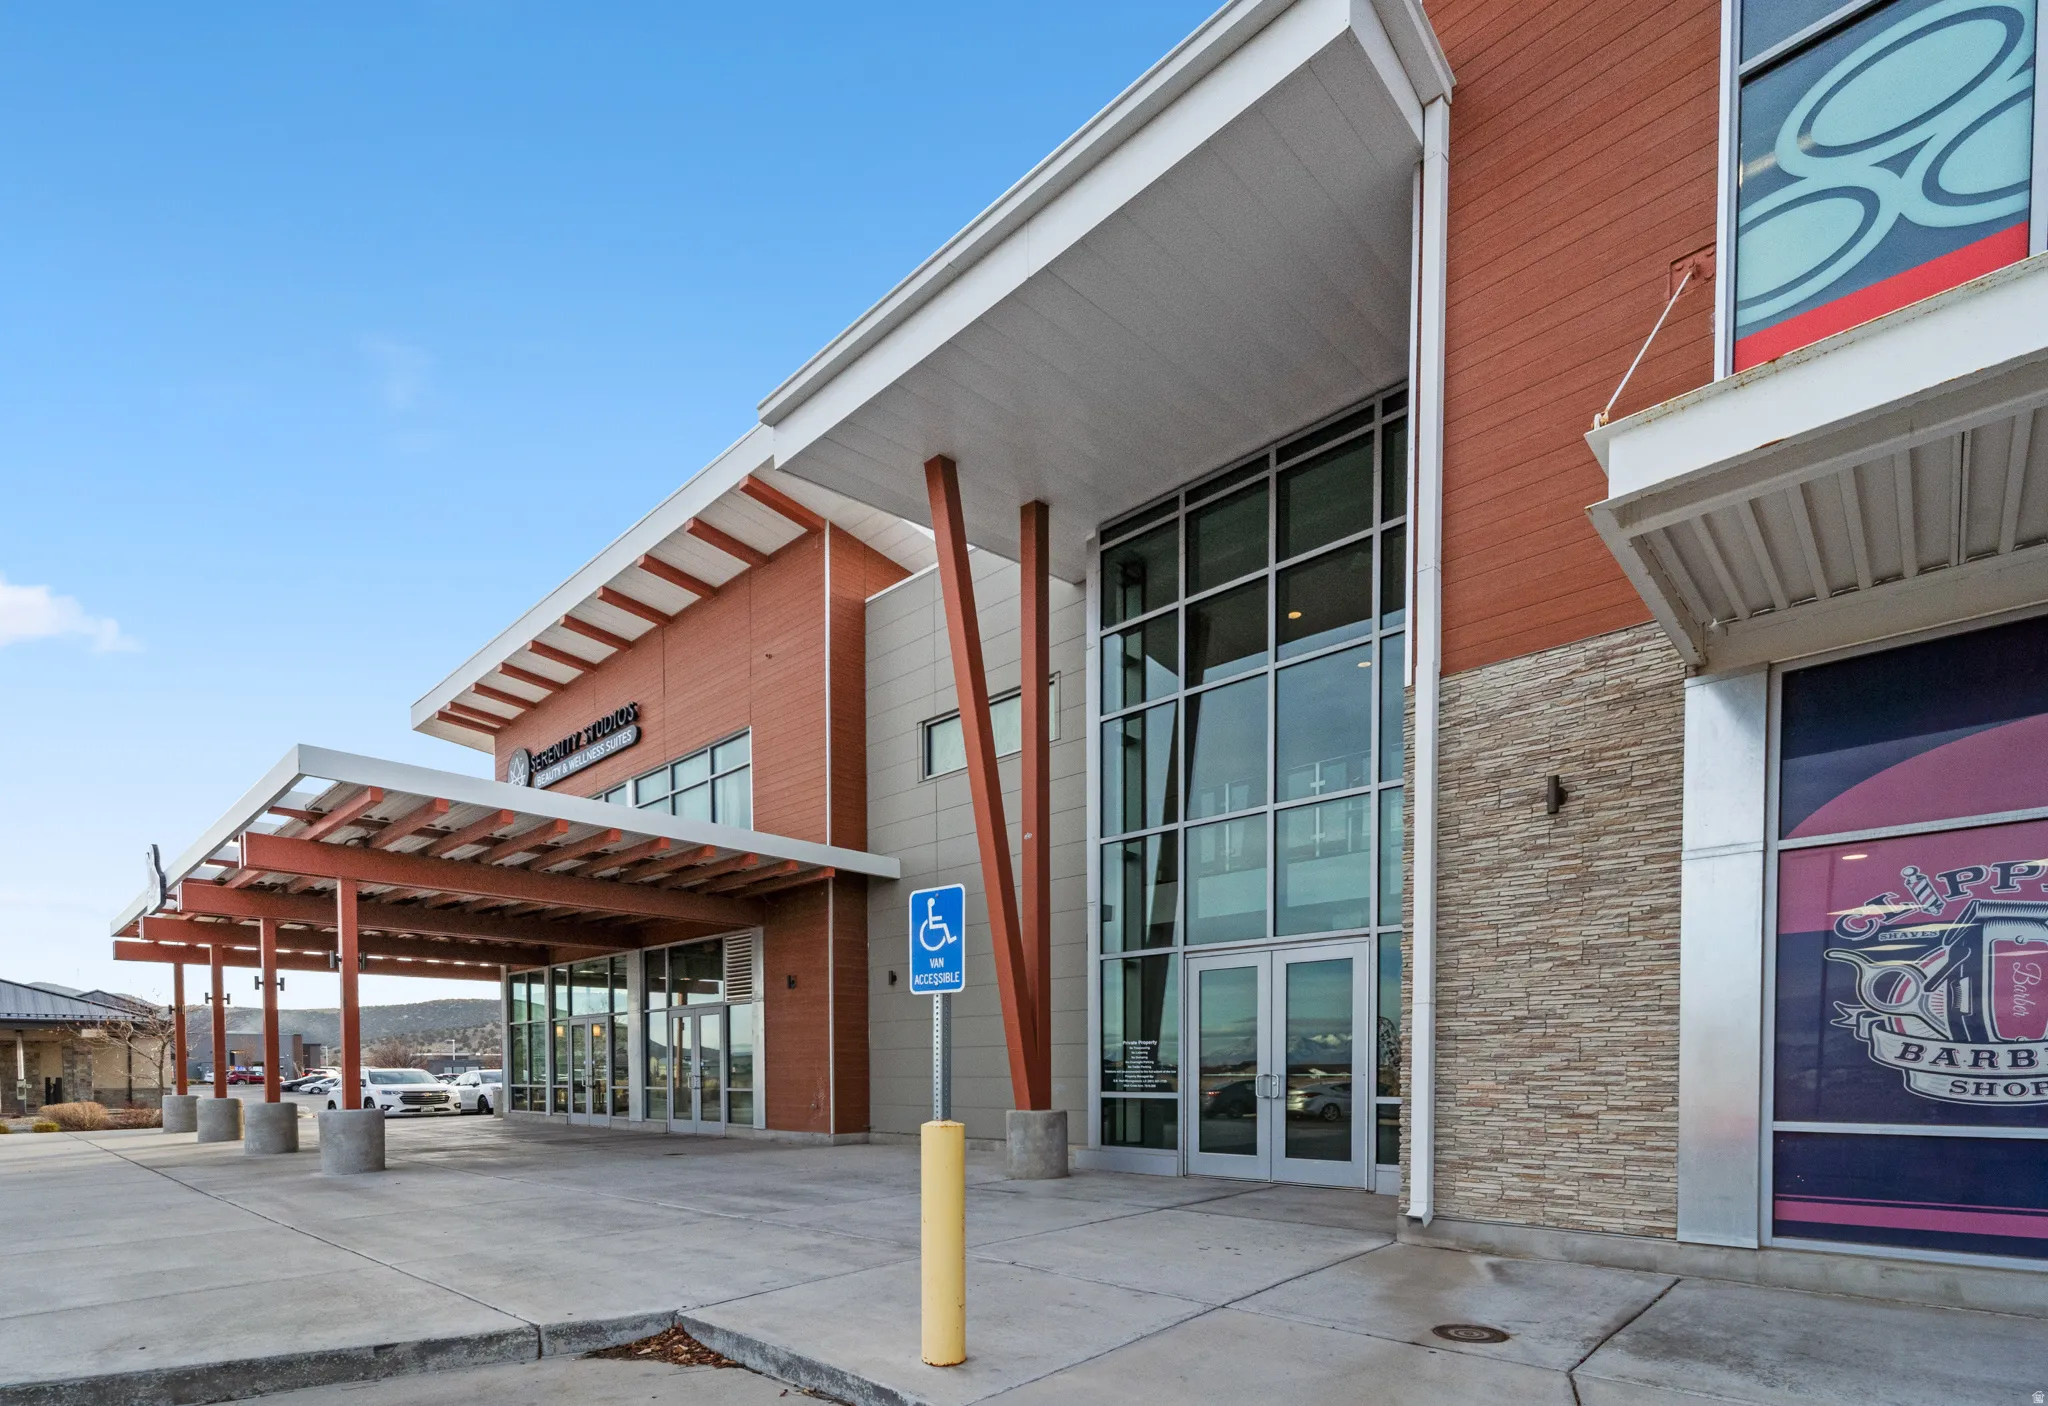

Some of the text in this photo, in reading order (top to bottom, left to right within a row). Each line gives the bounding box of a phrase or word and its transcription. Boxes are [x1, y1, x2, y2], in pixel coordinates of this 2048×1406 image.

[531, 702, 639, 772] SERENITY STUDIOS
[537, 729, 632, 786] BEAUTY & WELLNESS SUITES
[1833, 860, 2048, 941] CLIPP
[1879, 931, 1939, 941] SHAVES
[929, 957, 944, 968] VAN
[914, 971, 960, 985] ACCESSIBLE
[2012, 961, 2042, 1018] Barber
[1894, 1042, 2048, 1070] BARB
[1949, 1080, 2048, 1097] SHOP
